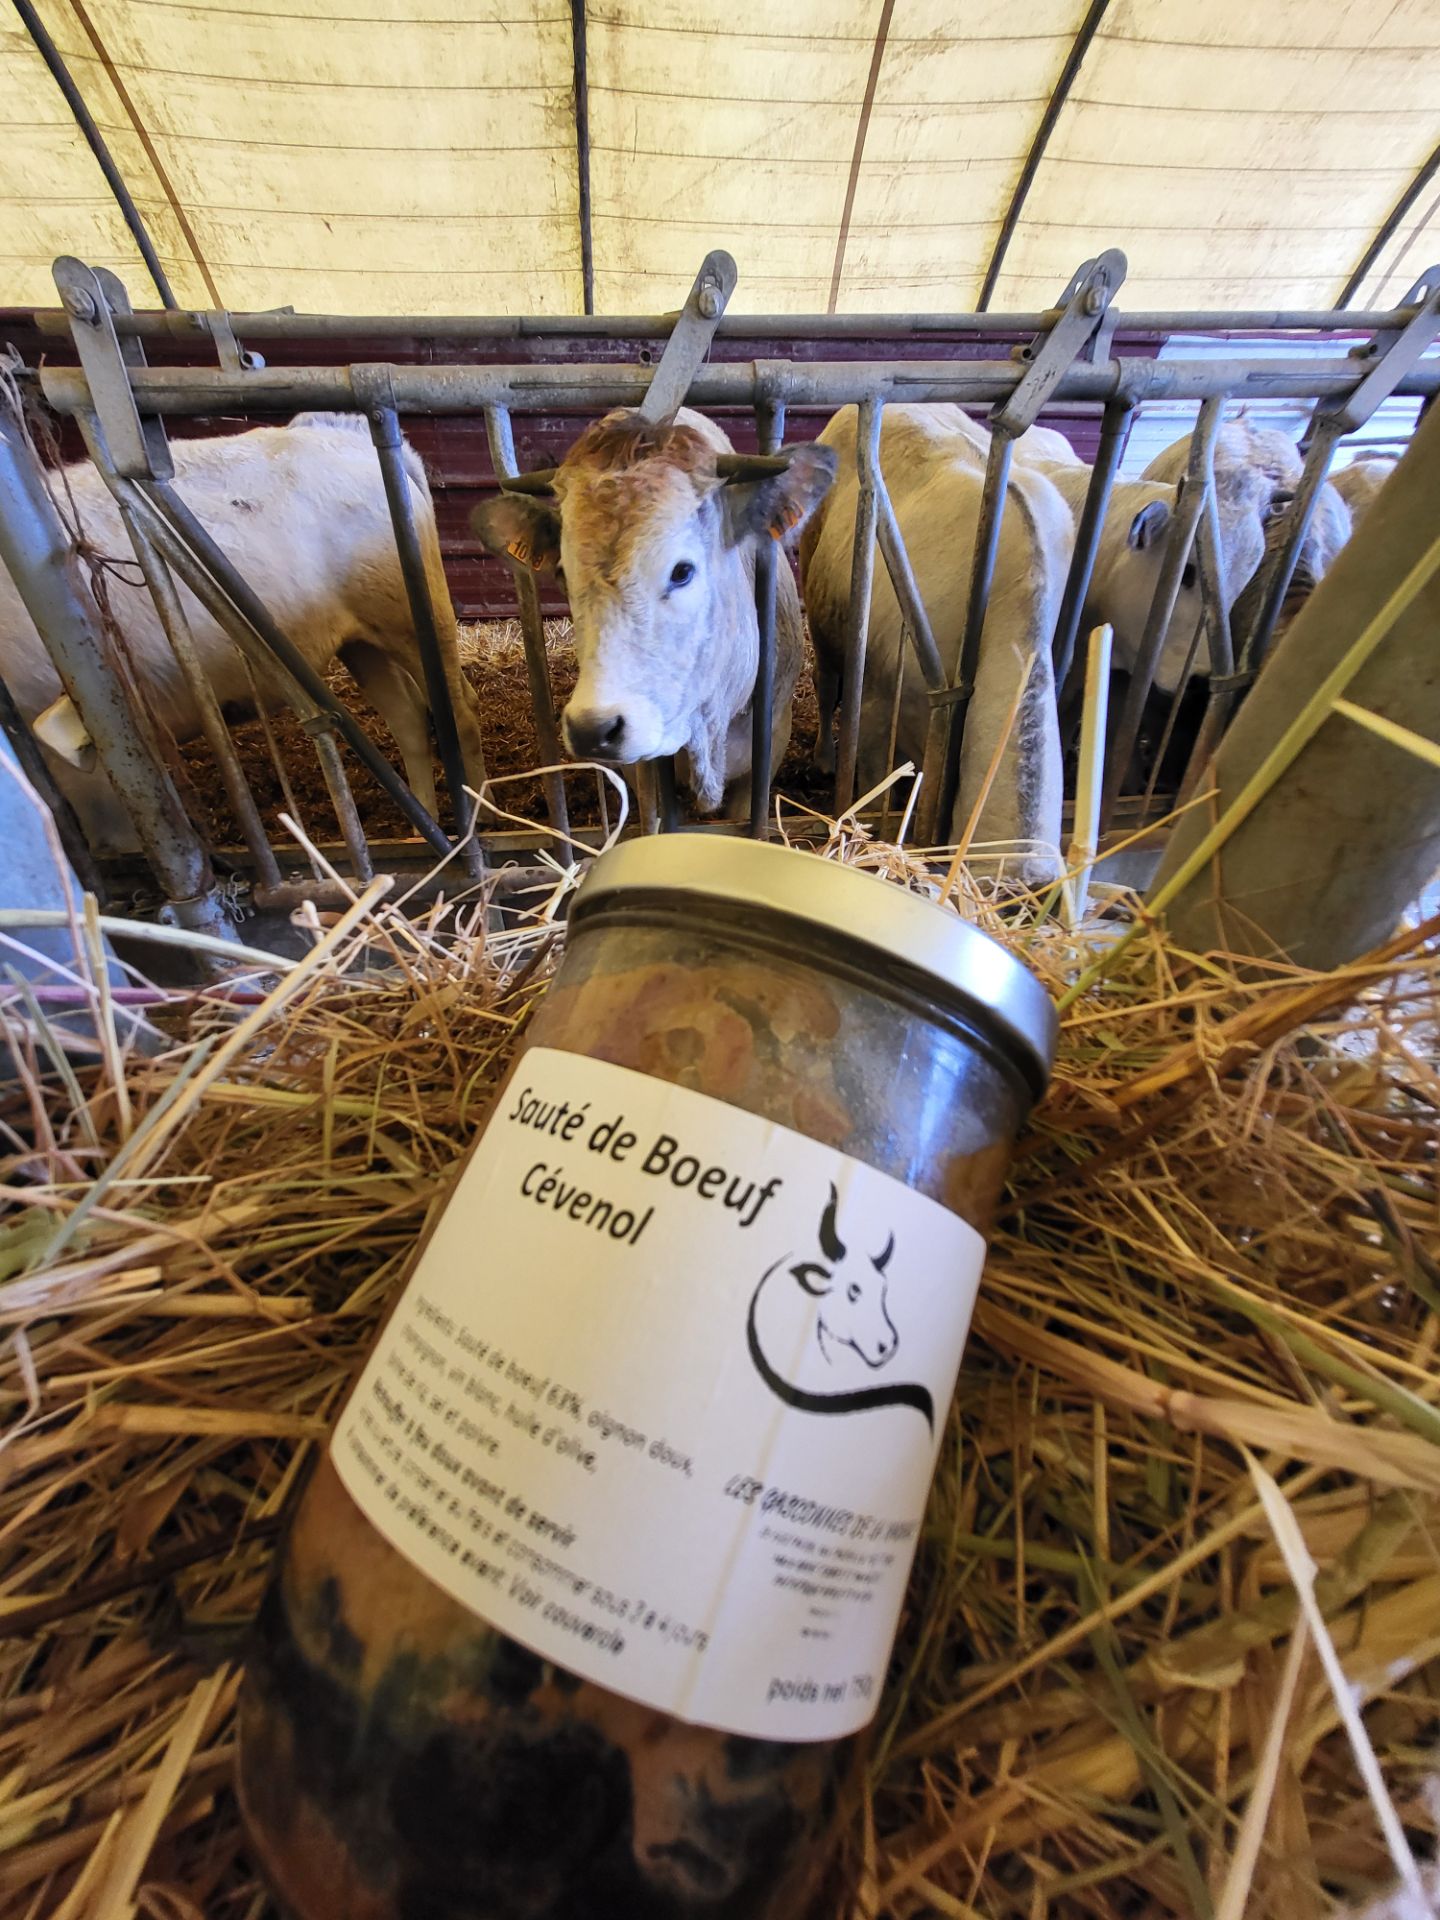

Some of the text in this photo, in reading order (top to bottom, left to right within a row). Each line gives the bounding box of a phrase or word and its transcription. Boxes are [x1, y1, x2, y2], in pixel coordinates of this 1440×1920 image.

[509, 1088, 783, 1227] Sauté de Boeuf
[520, 1163, 655, 1246] Cévenol
[587, 1409, 648, 1443] oignon
